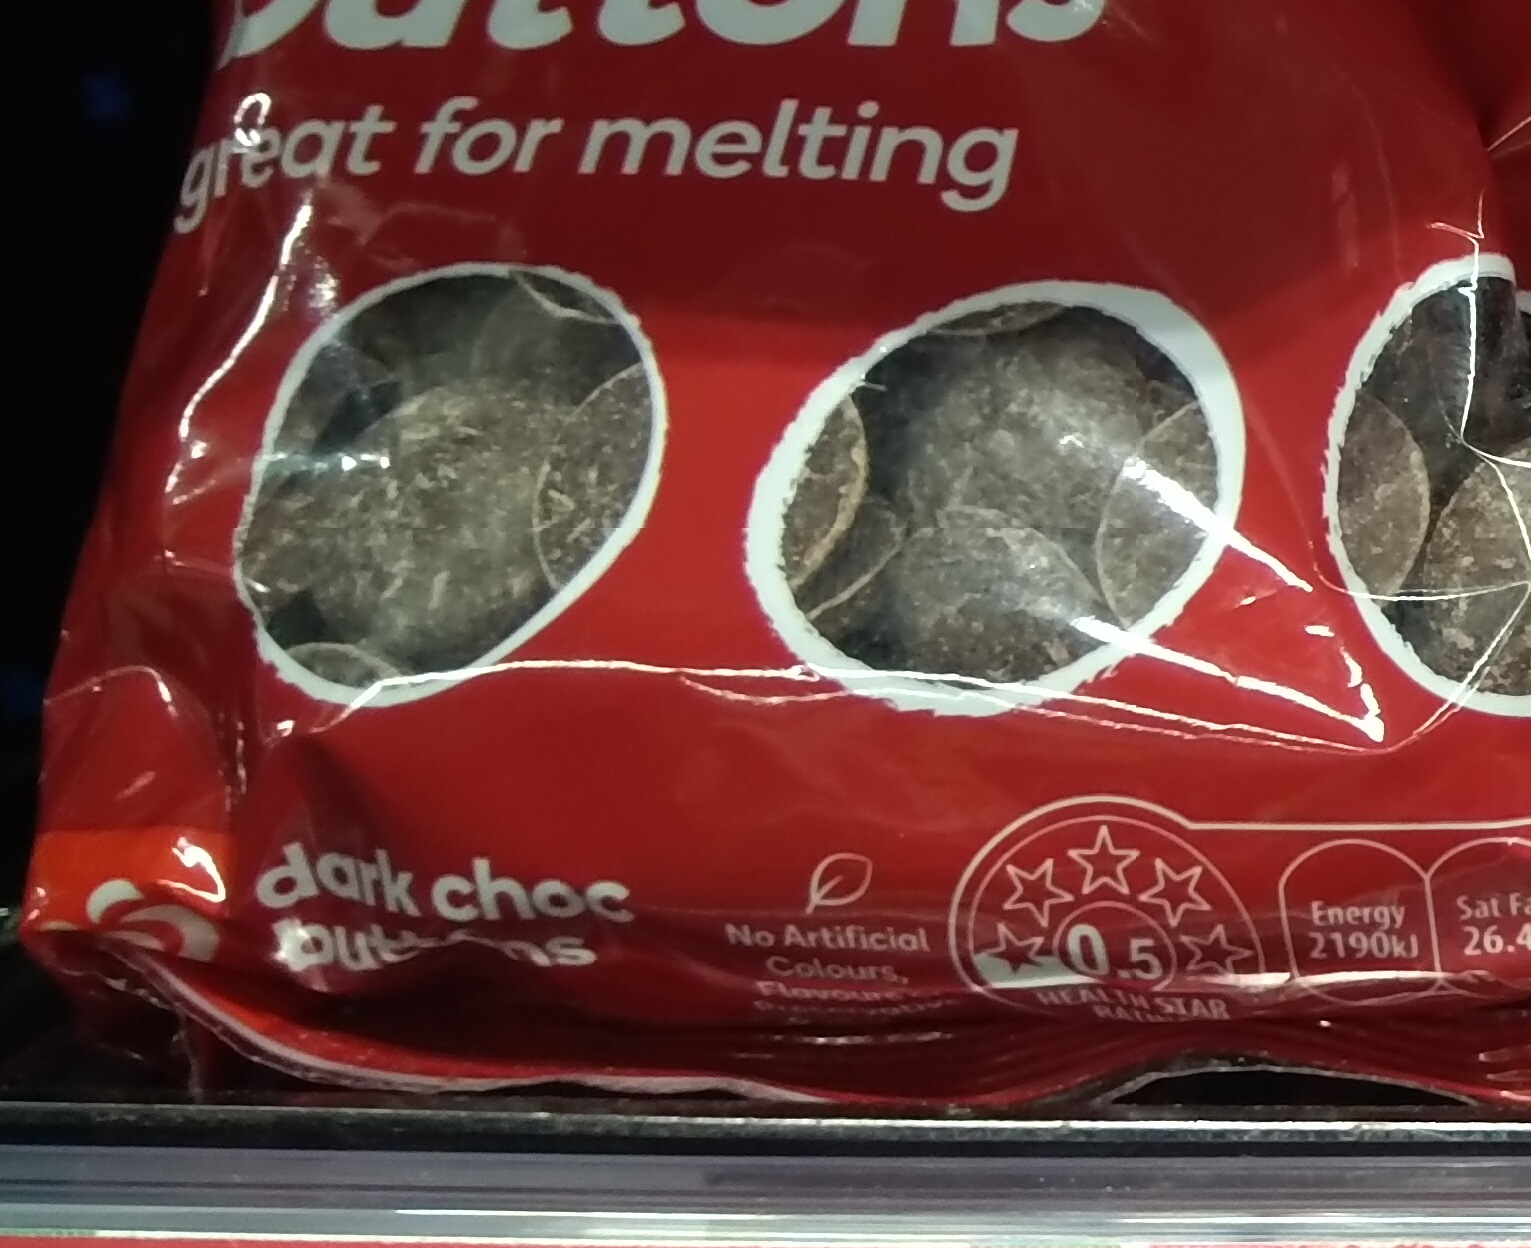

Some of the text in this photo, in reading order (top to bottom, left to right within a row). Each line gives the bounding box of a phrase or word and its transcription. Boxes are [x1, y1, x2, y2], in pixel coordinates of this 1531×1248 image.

[174, 95, 1018, 236] great for melting
[255, 841, 635, 923] dark choc
[1311, 900, 1406, 933] Energy
[1456, 895, 1505, 922] Sat
[724, 923, 932, 952] No Artificial
[1066, 923, 1164, 981] 0.5
[1153, 997, 1232, 1021] STAR
